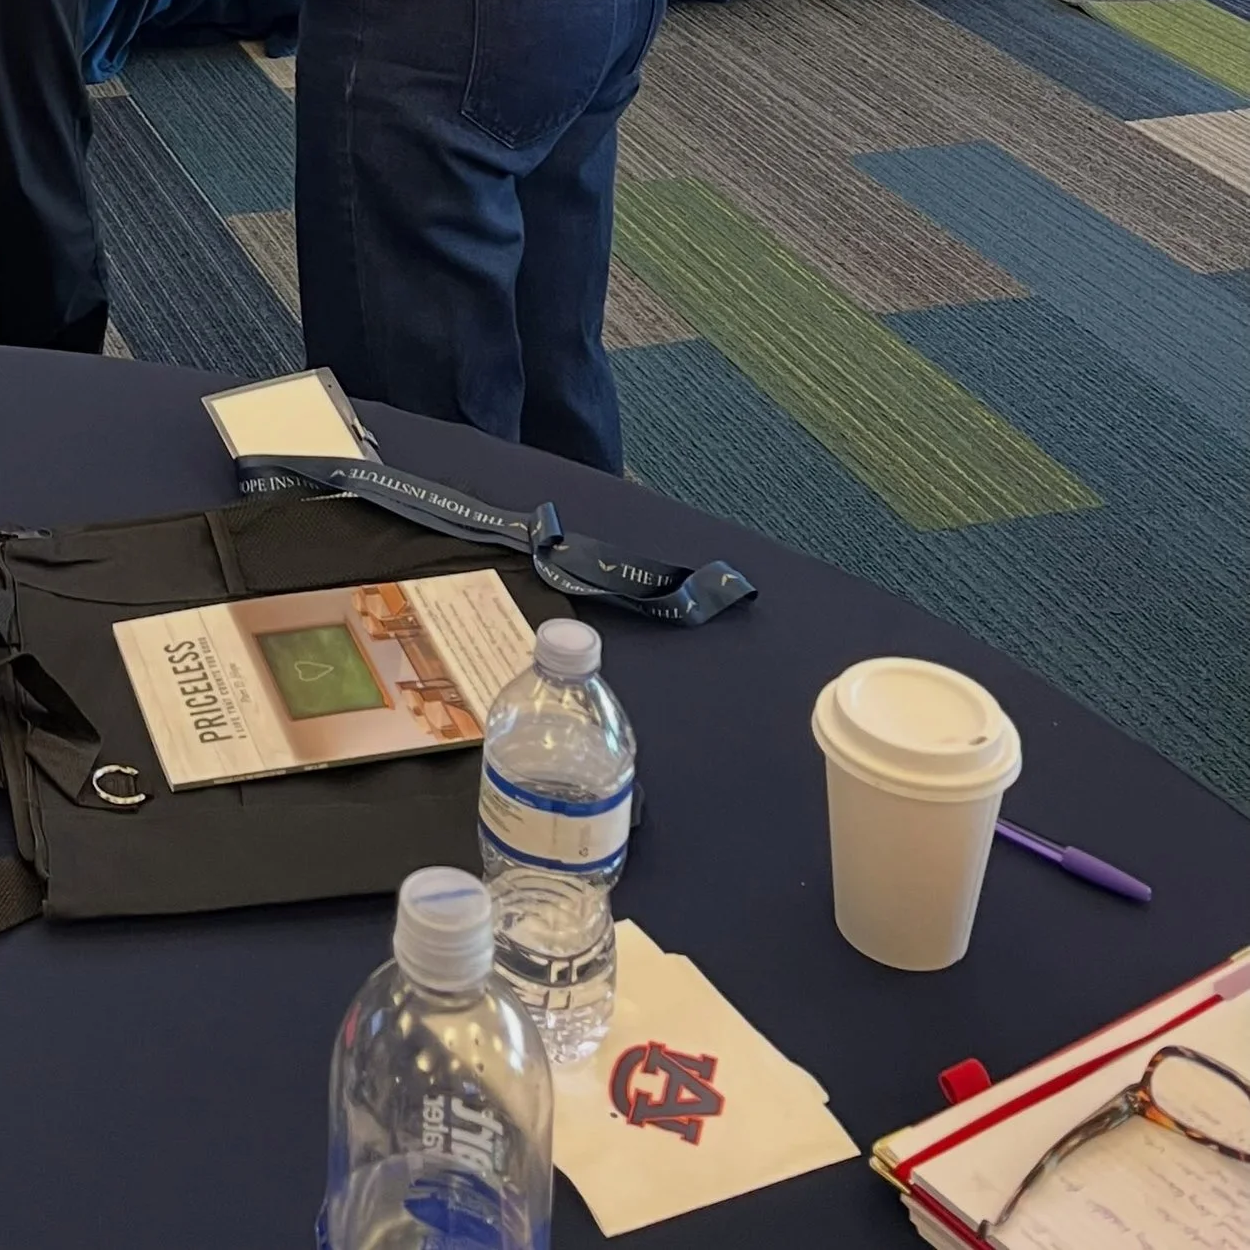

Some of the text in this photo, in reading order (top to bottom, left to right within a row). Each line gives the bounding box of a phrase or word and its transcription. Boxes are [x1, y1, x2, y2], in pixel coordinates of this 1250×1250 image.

[238, 477, 267, 493] OPE
[348, 468, 506, 528] THE HOPE INSTITUTE
[621, 563, 653, 586] THE
[163, 640, 233, 743] PRICELESS
